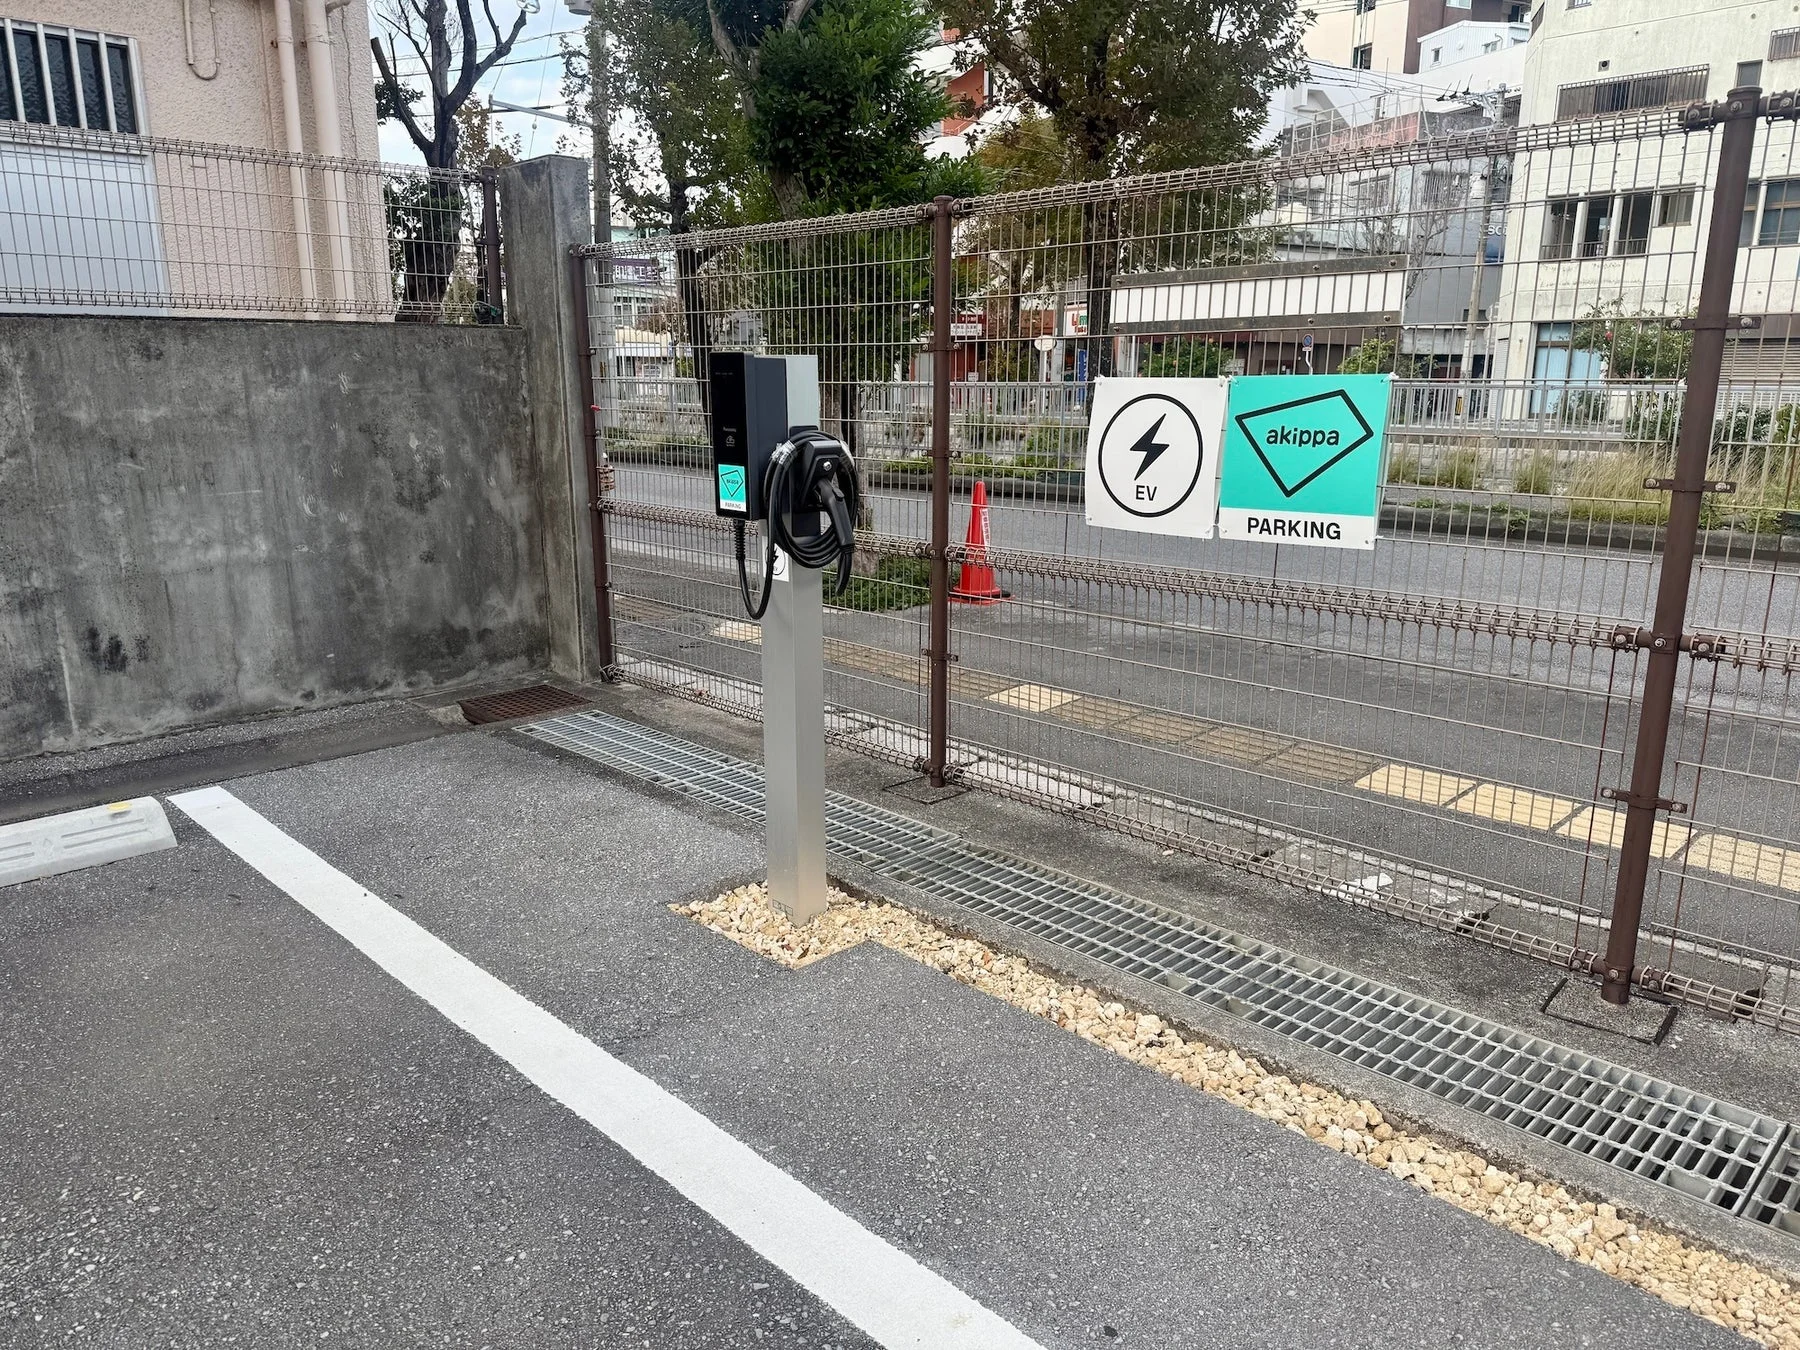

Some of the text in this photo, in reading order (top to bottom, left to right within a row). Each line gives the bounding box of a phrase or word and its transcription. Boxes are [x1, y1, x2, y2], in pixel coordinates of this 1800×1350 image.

[1266, 426, 1340, 447] akippa
[1136, 485, 1157, 501] EV
[1247, 517, 1341, 540] PARKING
